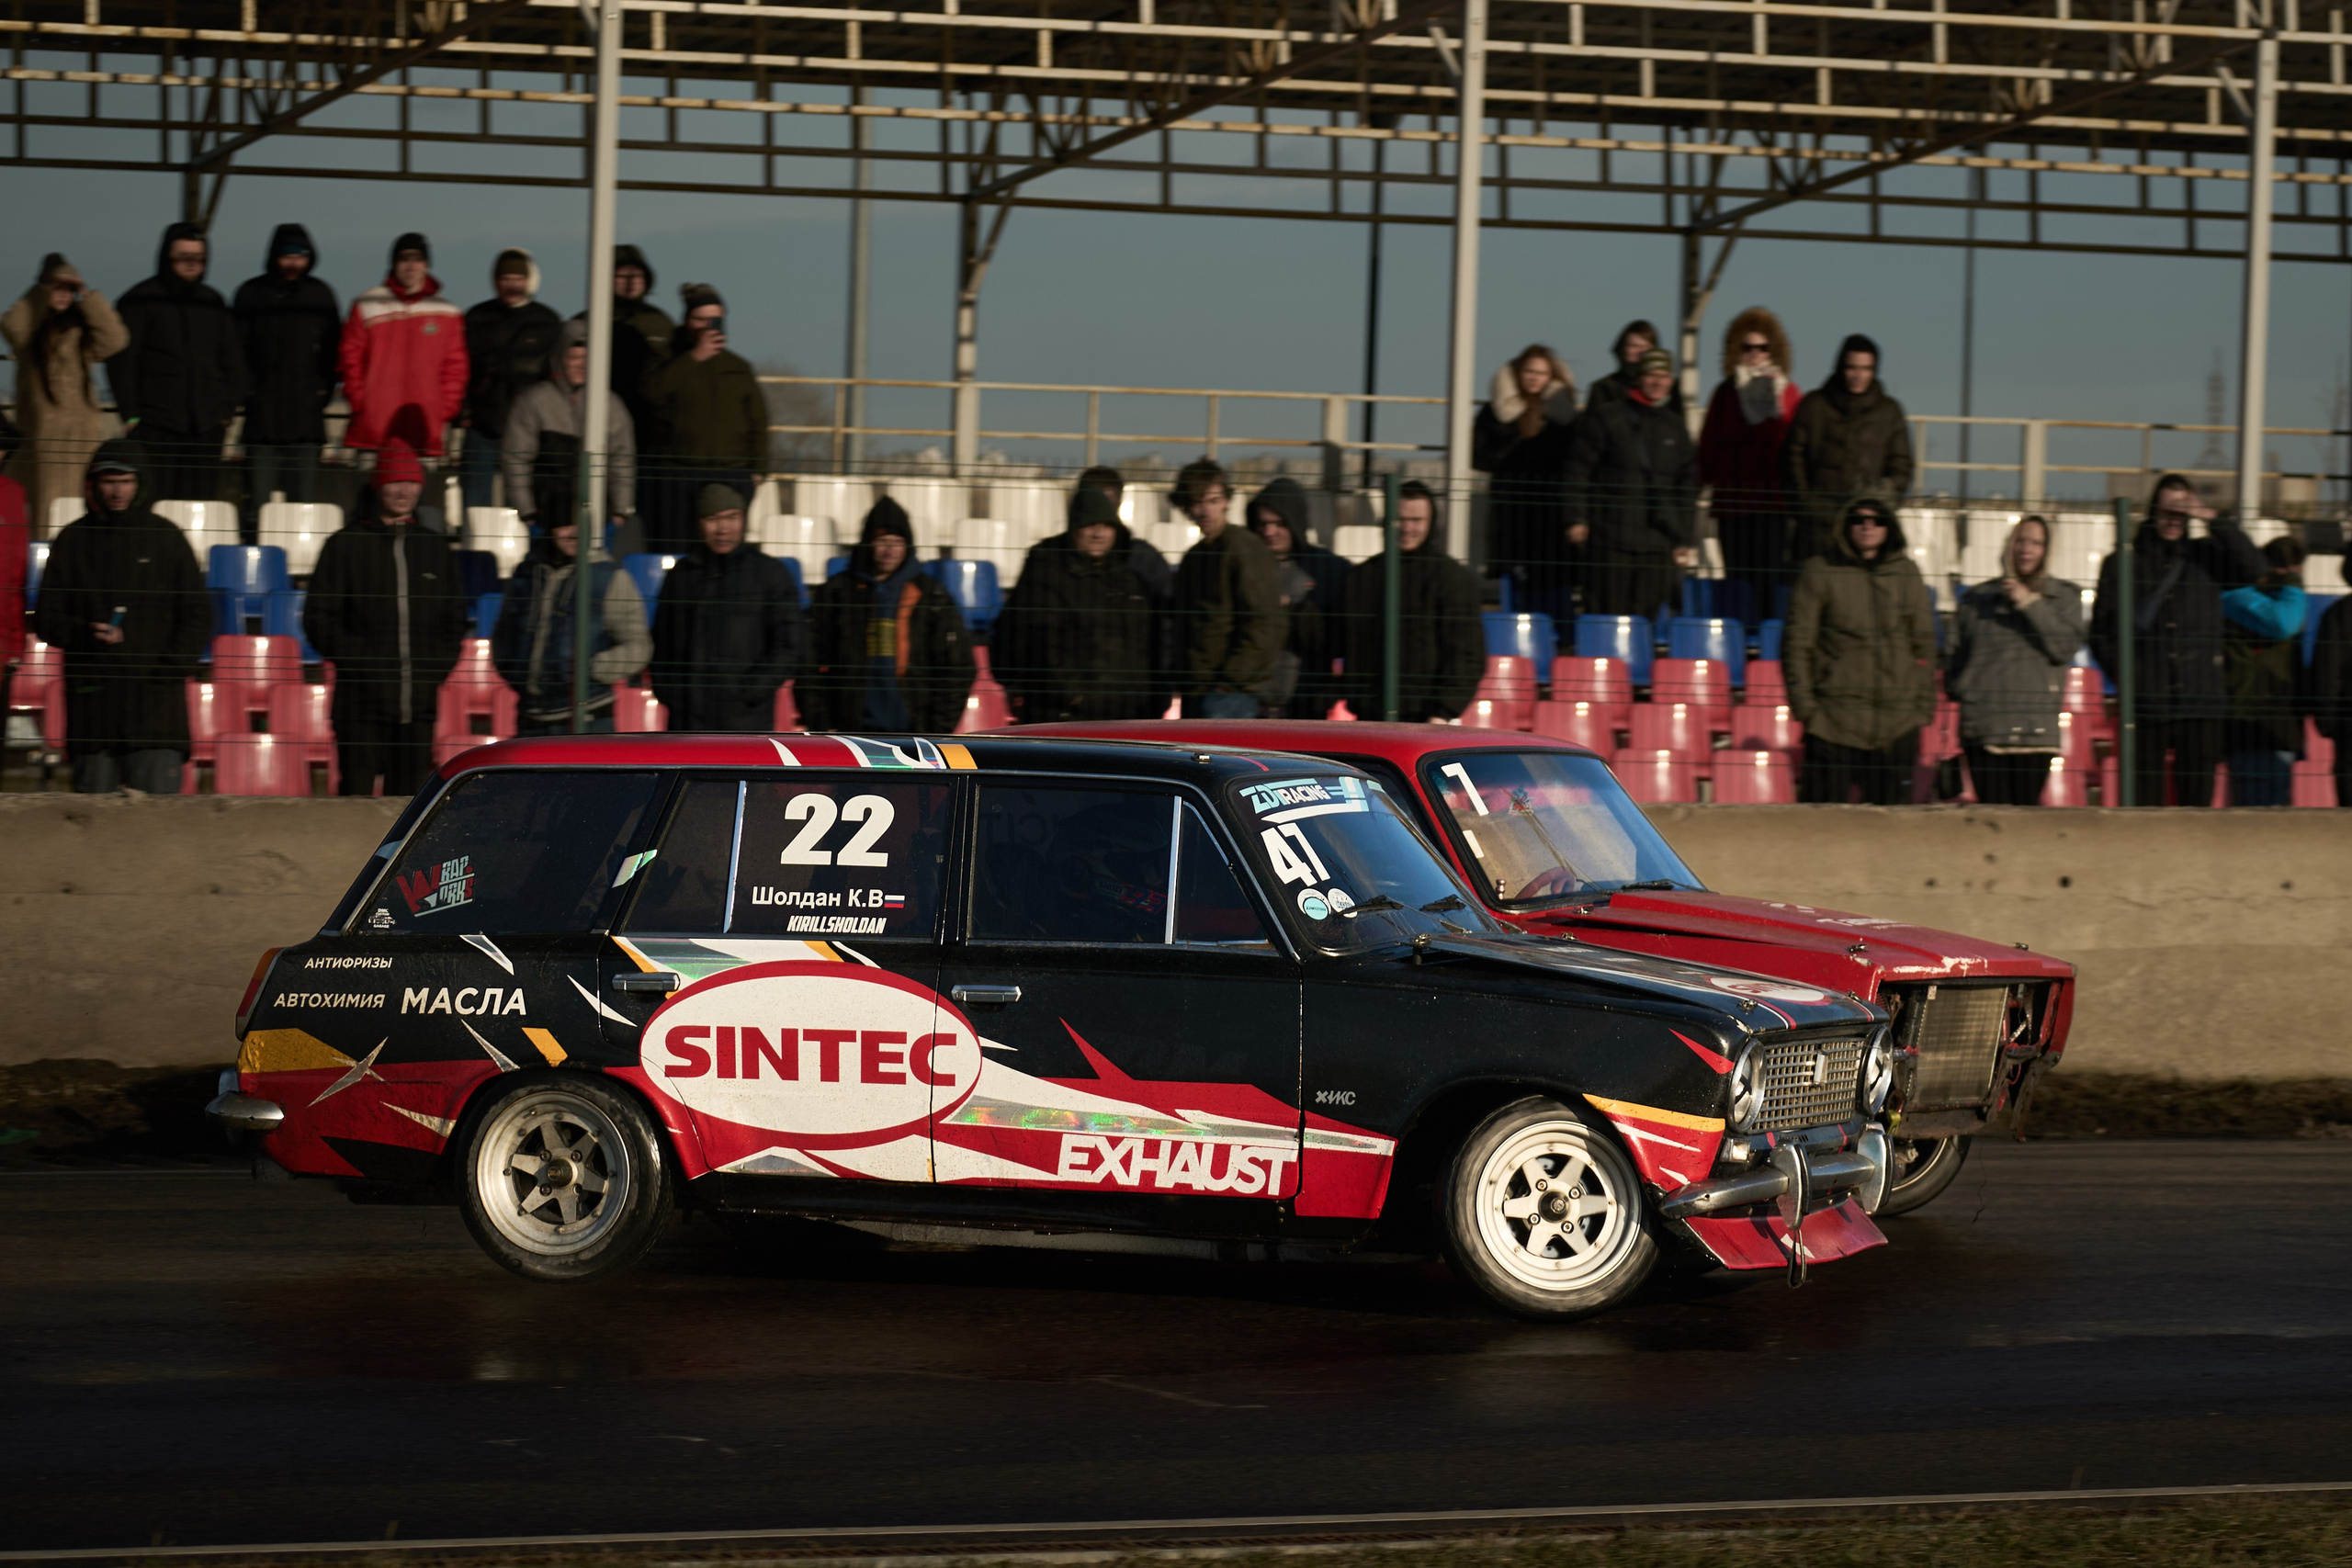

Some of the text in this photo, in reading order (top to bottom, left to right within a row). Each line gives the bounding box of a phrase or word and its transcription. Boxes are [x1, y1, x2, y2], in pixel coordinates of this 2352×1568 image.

[1277, 784, 1331, 805] RACING
[780, 793, 895, 867] 22
[1260, 822, 1331, 886] 47
[752, 886, 884, 908] Шолдан К.В
[786, 915, 888, 934] KIRILLSHOLDAN
[304, 956, 393, 969] АНТИФРИЗЫ
[274, 993, 385, 1009] АВТОХИМИЯ
[401, 987, 526, 1016] МАСЛА
[664, 1025, 957, 1087] SINTEC
[1057, 1133, 1298, 1196] EXHAUST
